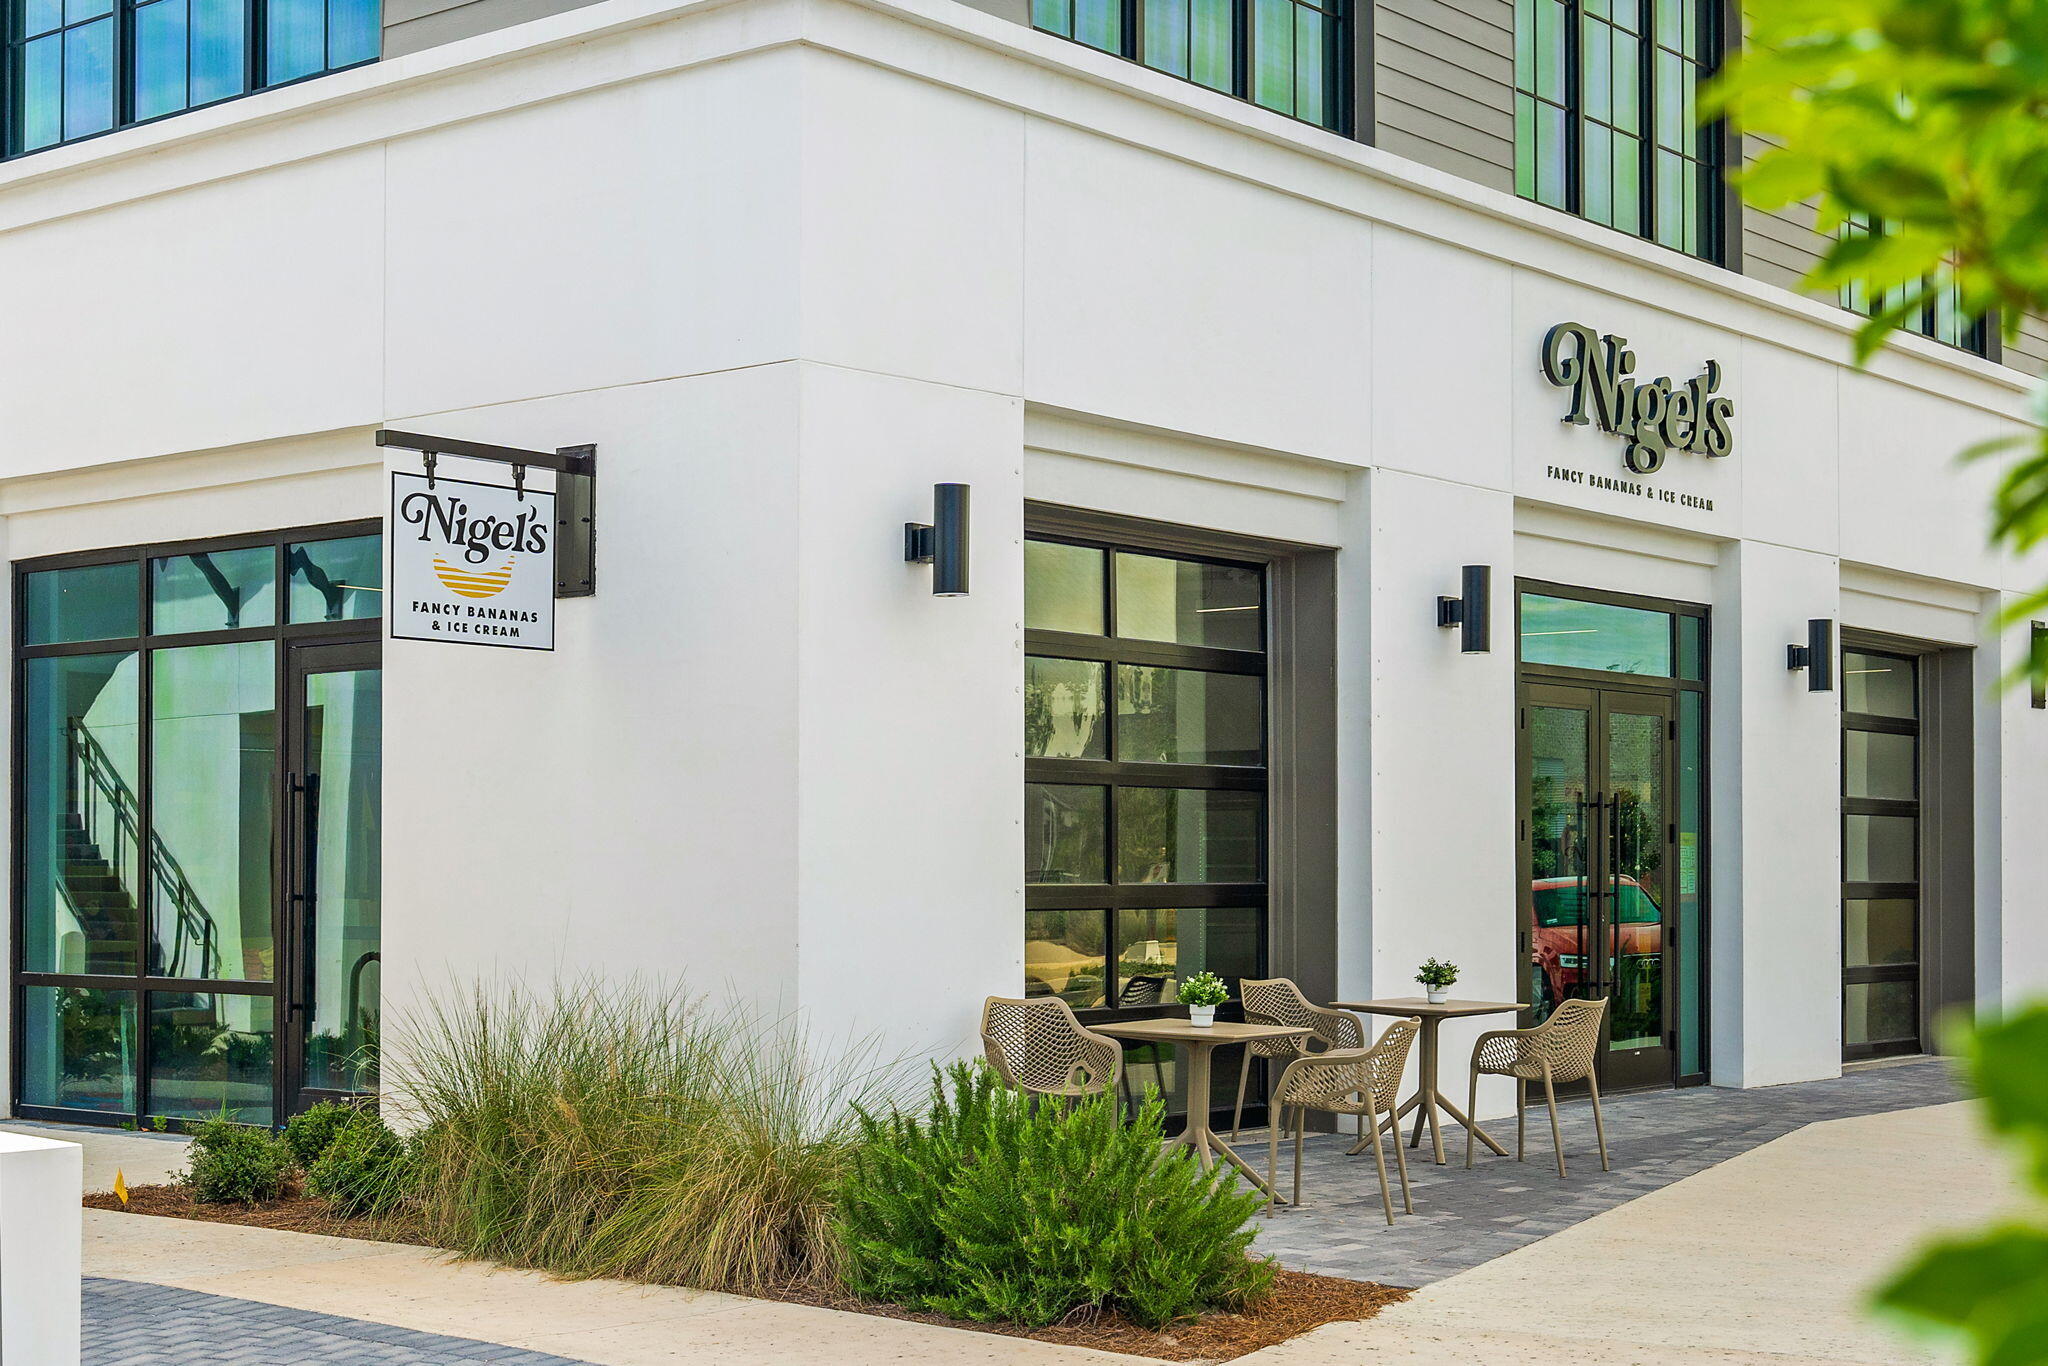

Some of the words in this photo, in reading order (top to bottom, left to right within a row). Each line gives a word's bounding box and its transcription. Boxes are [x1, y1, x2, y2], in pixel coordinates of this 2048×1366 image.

[1541, 321, 1734, 474] Nigel's
[1547, 465, 1584, 484] FANCY
[1589, 474, 1642, 496] BANANAS
[1647, 487, 1654, 499] &
[1659, 489, 1675, 503] ICE
[1680, 494, 1714, 511] CREAM
[401, 492, 548, 564] Nigel's
[412, 601, 461, 616] FANCY
[467, 606, 539, 623] BANANAS
[431, 620, 441, 631] &
[447, 621, 468, 633] ICE
[474, 624, 520, 638] CREAM
